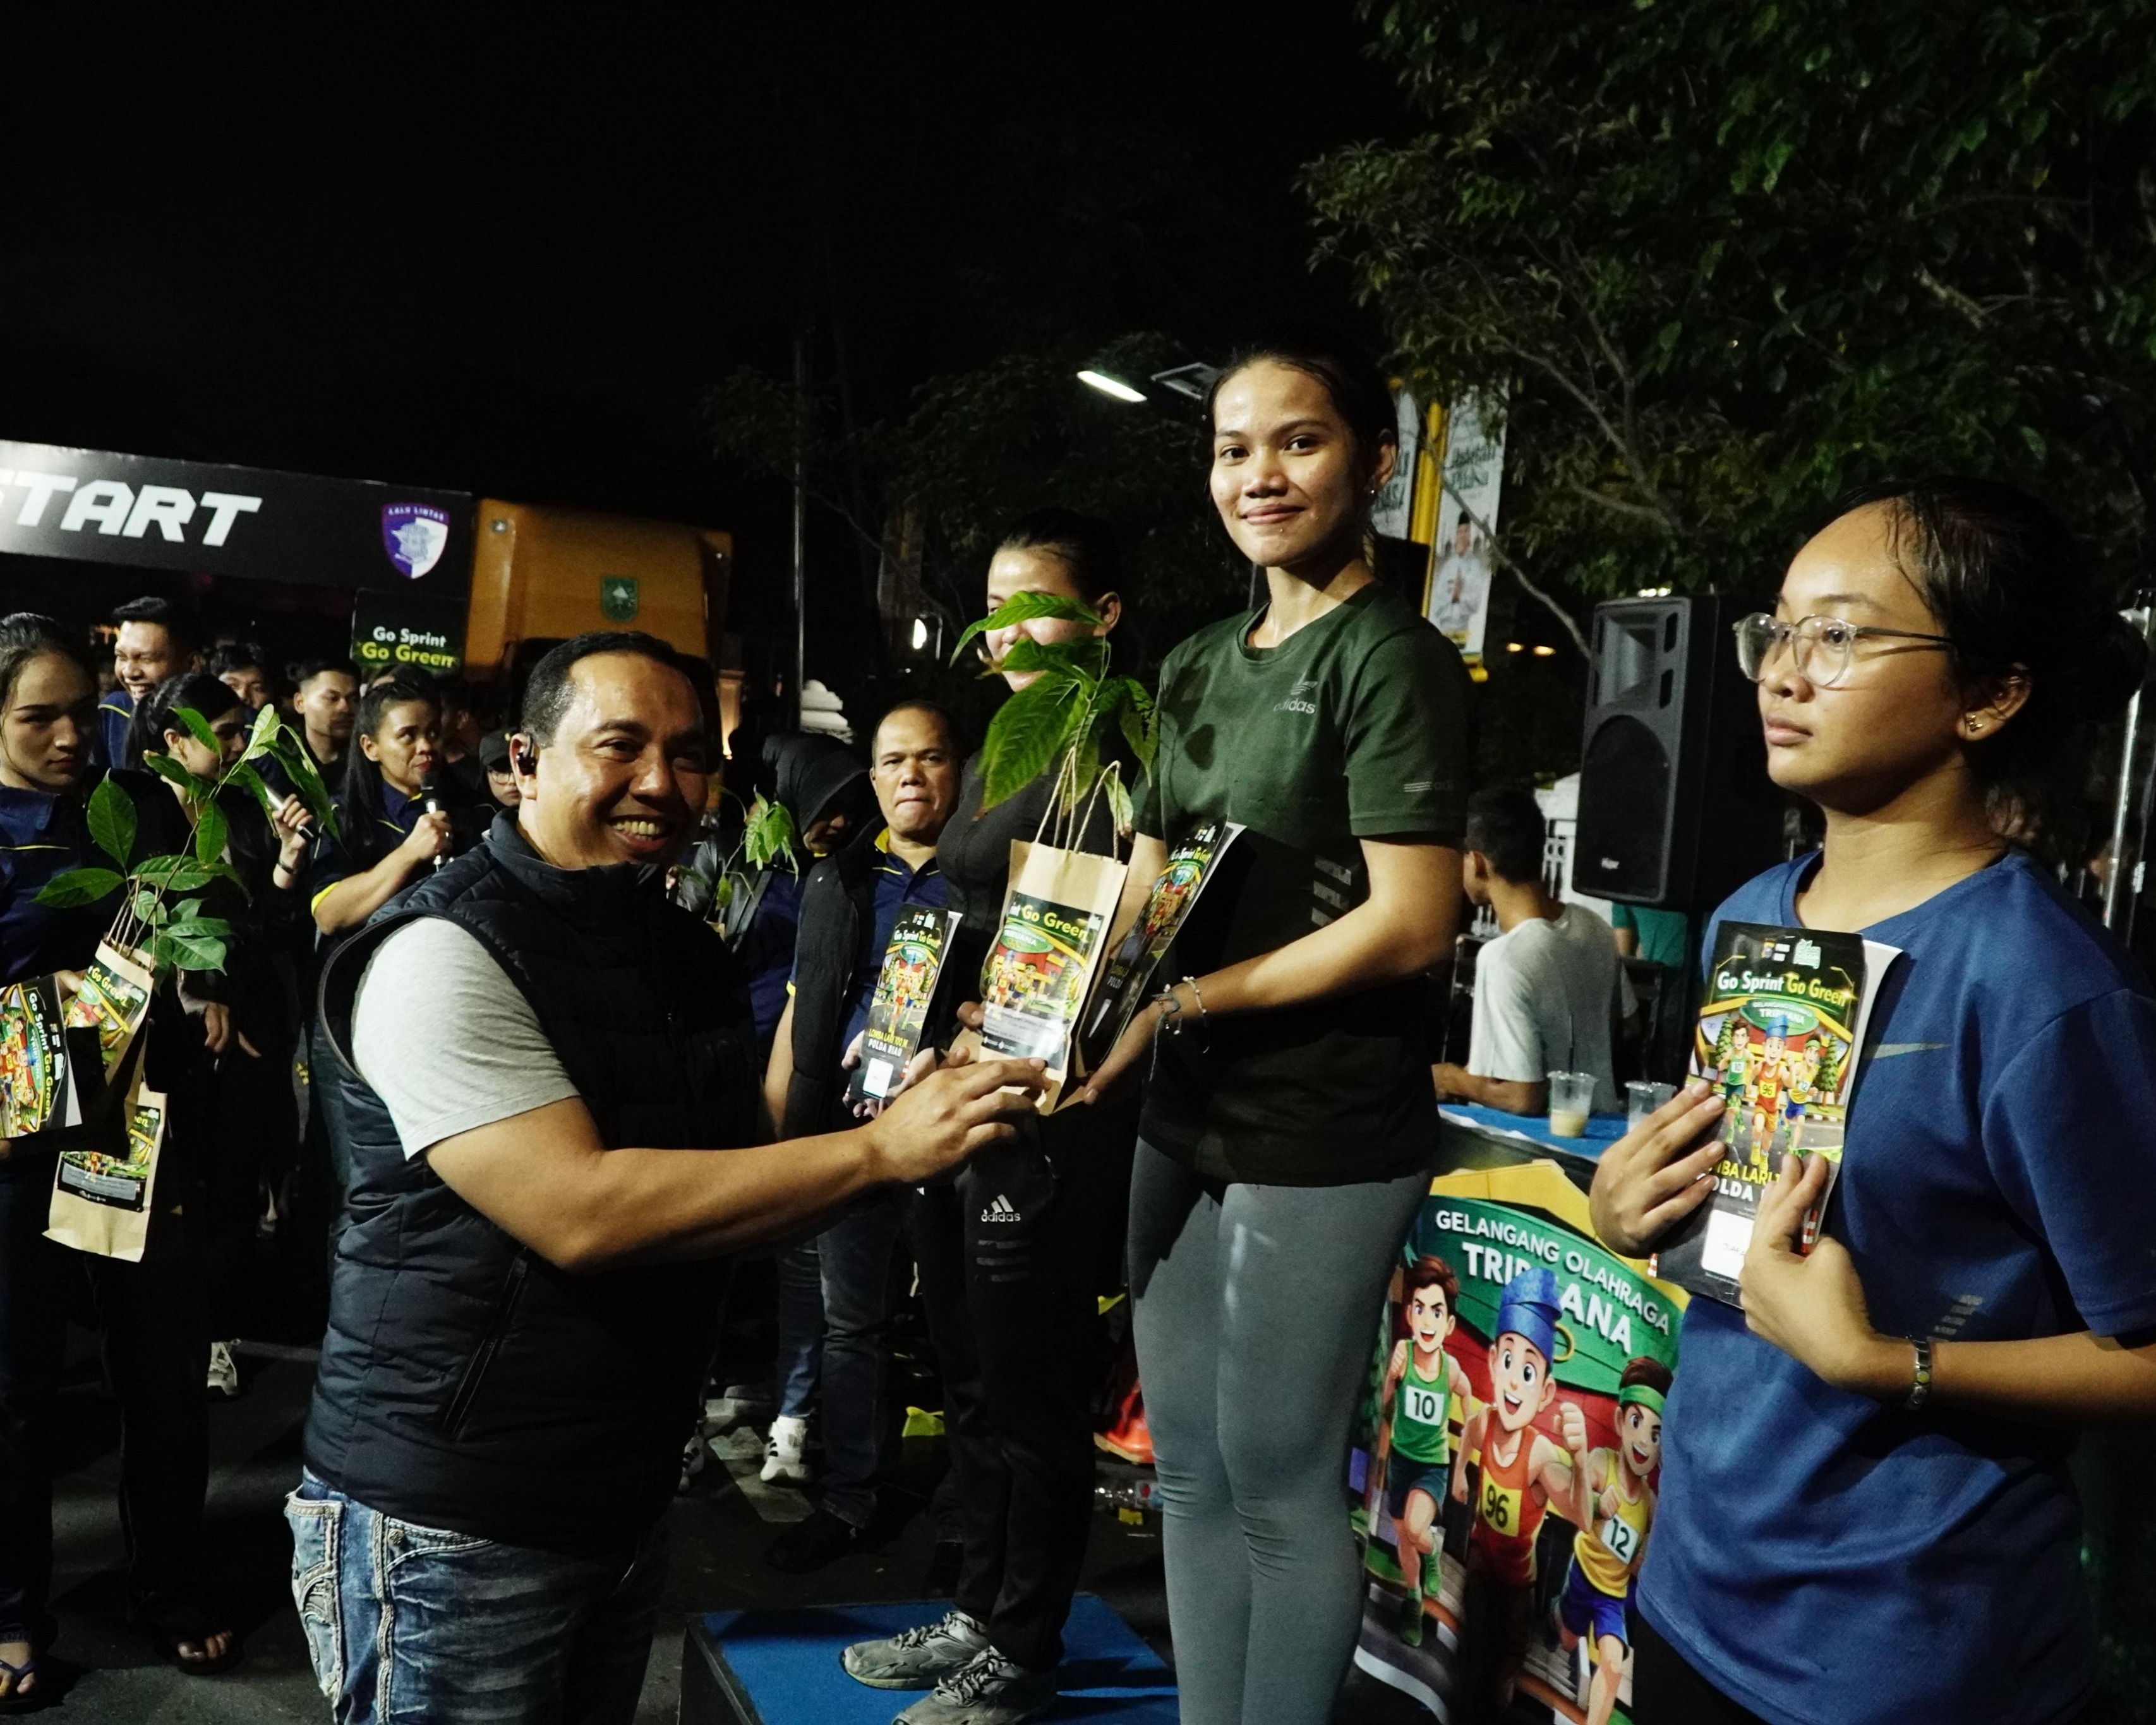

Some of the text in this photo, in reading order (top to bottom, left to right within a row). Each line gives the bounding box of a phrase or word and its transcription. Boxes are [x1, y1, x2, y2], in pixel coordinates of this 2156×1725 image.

[0, 467, 263, 547] TART
[361, 641, 454, 669] Go Green
[373, 626, 447, 647] Go Sprint
[1021, 905, 1040, 922] Go
[1044, 912, 1088, 944] Green
[91, 967, 102, 982] Go
[101, 976, 128, 1008] Green
[1718, 970, 1848, 1007] Go Sprint Go Green
[29, 992, 38, 1011] Go
[35, 1013, 50, 1051] Sprint
[44, 1053, 52, 1073] Go
[868, 1038, 888, 1053] POLDA
[1762, 1084, 1774, 1095] 96
[980, 1211, 1021, 1223] adidas
[1435, 1209, 1671, 1337] GELANGANG OLAHRAGA
[1462, 1241, 1632, 1355] TRIANA
[1413, 1391, 1436, 1420] 10
[1485, 1484, 1510, 1529] 96
[1610, 1513, 1630, 1559] 12
